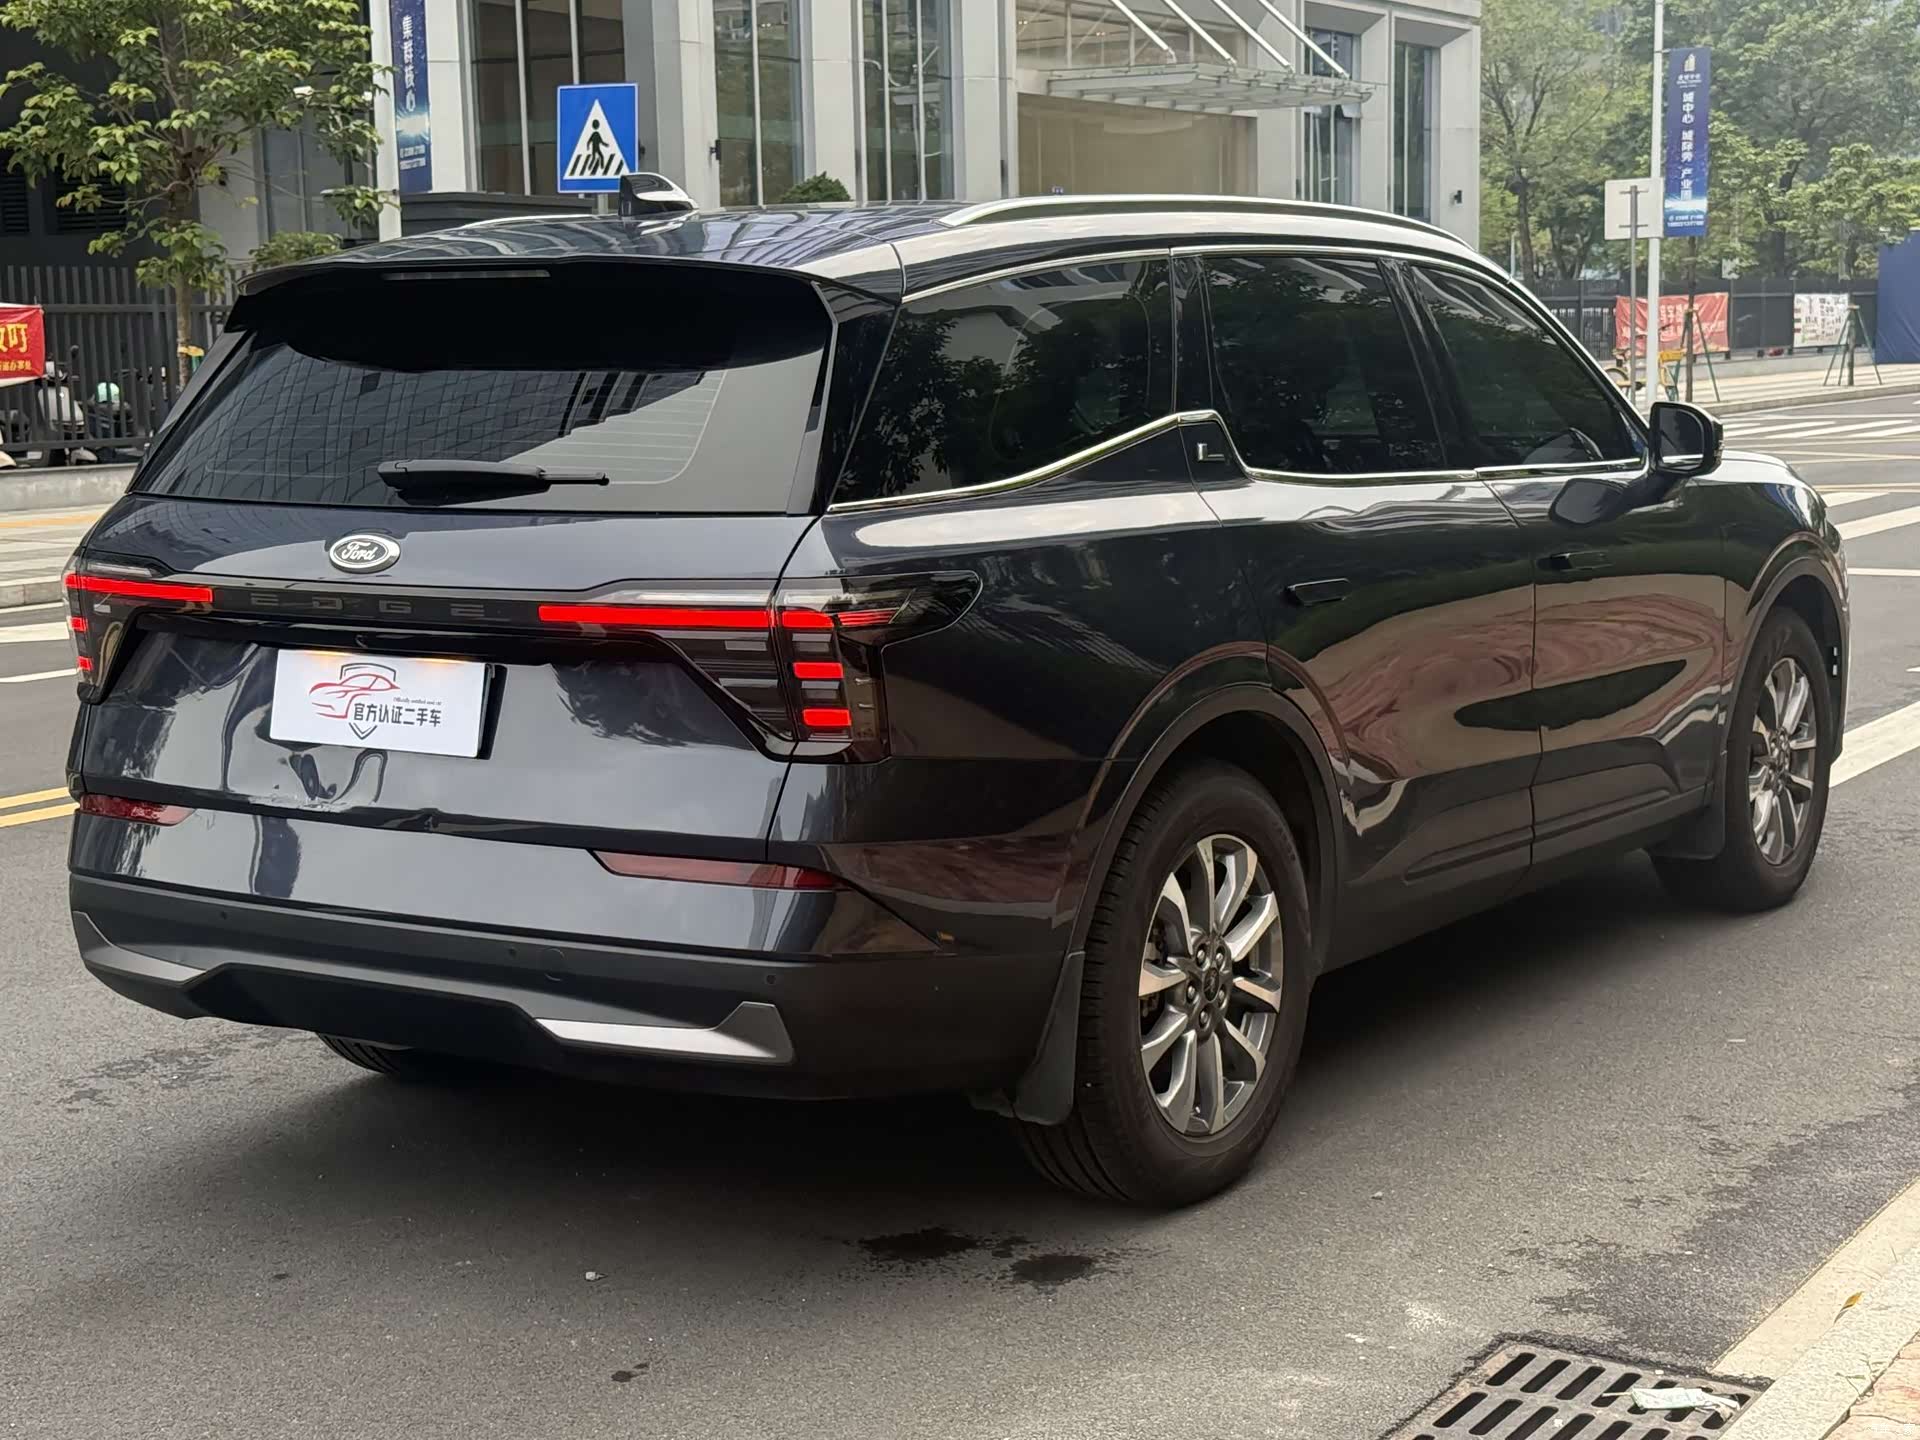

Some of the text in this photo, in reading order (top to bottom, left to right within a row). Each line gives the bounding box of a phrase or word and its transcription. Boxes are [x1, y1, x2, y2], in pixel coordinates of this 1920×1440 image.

[341, 541, 379, 560] Ford
[250, 593, 485, 617] EDGE
[354, 703, 441, 727] 官方认证二手车
